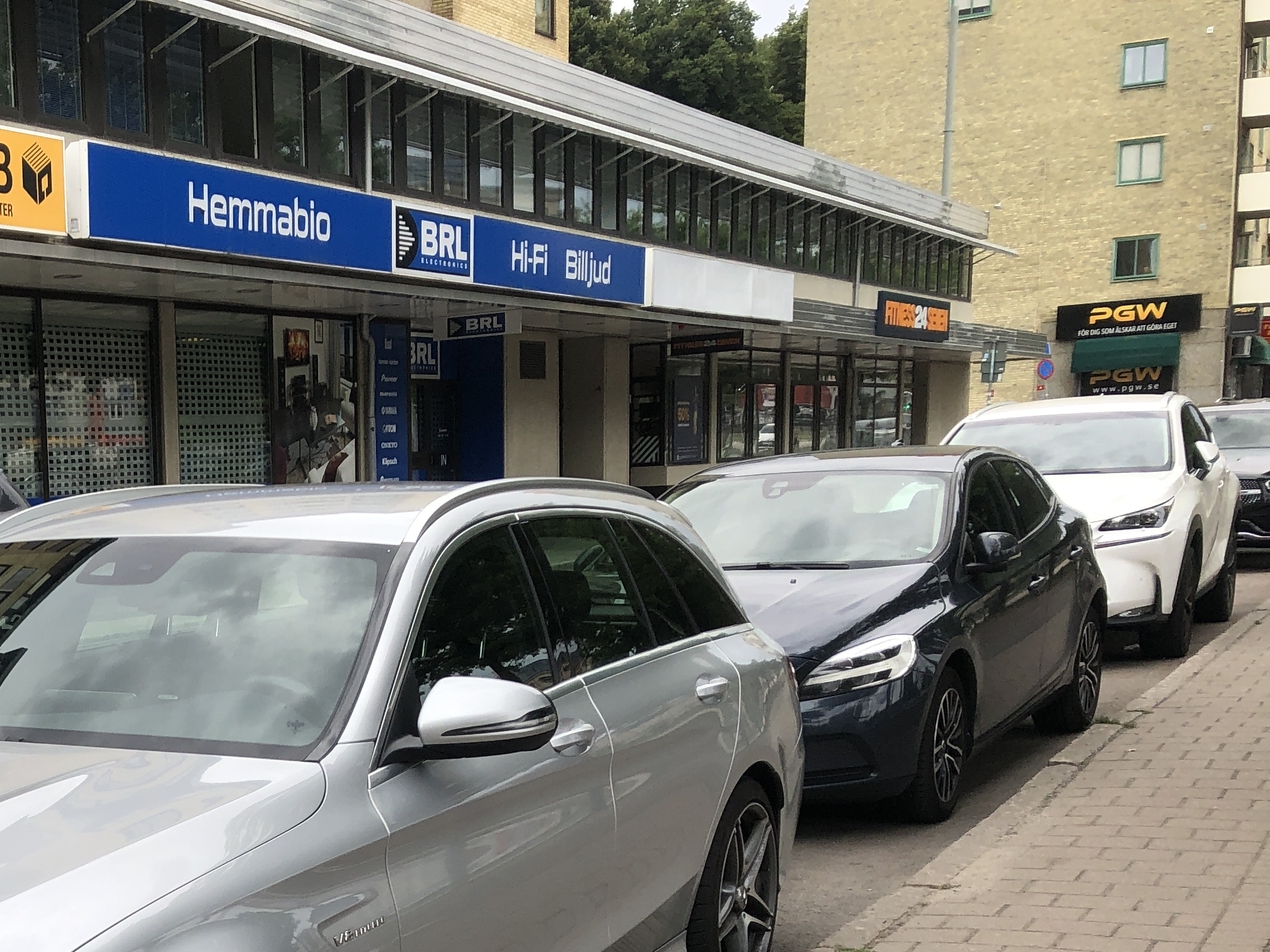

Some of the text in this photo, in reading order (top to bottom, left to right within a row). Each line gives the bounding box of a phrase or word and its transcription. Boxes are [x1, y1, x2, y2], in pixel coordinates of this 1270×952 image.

[188, 181, 331, 242] Hemmabio
[420, 220, 468, 261] BRL
[420, 257, 468, 270] ELECTRONICS
[511, 239, 612, 288] Hi-Fi Billjud
[1089, 301, 1168, 325] PGW
[465, 315, 503, 331] BRL
[1077, 328, 1089, 337] FÖR
[1090, 328, 1100, 336] DIG
[1101, 327, 1114, 335] SOM
[1136, 324, 1146, 332] ATT
[1163, 321, 1178, 330] EGET
[1089, 366, 1162, 385] PGW
[1092, 383, 1160, 394] www.pgw.se
